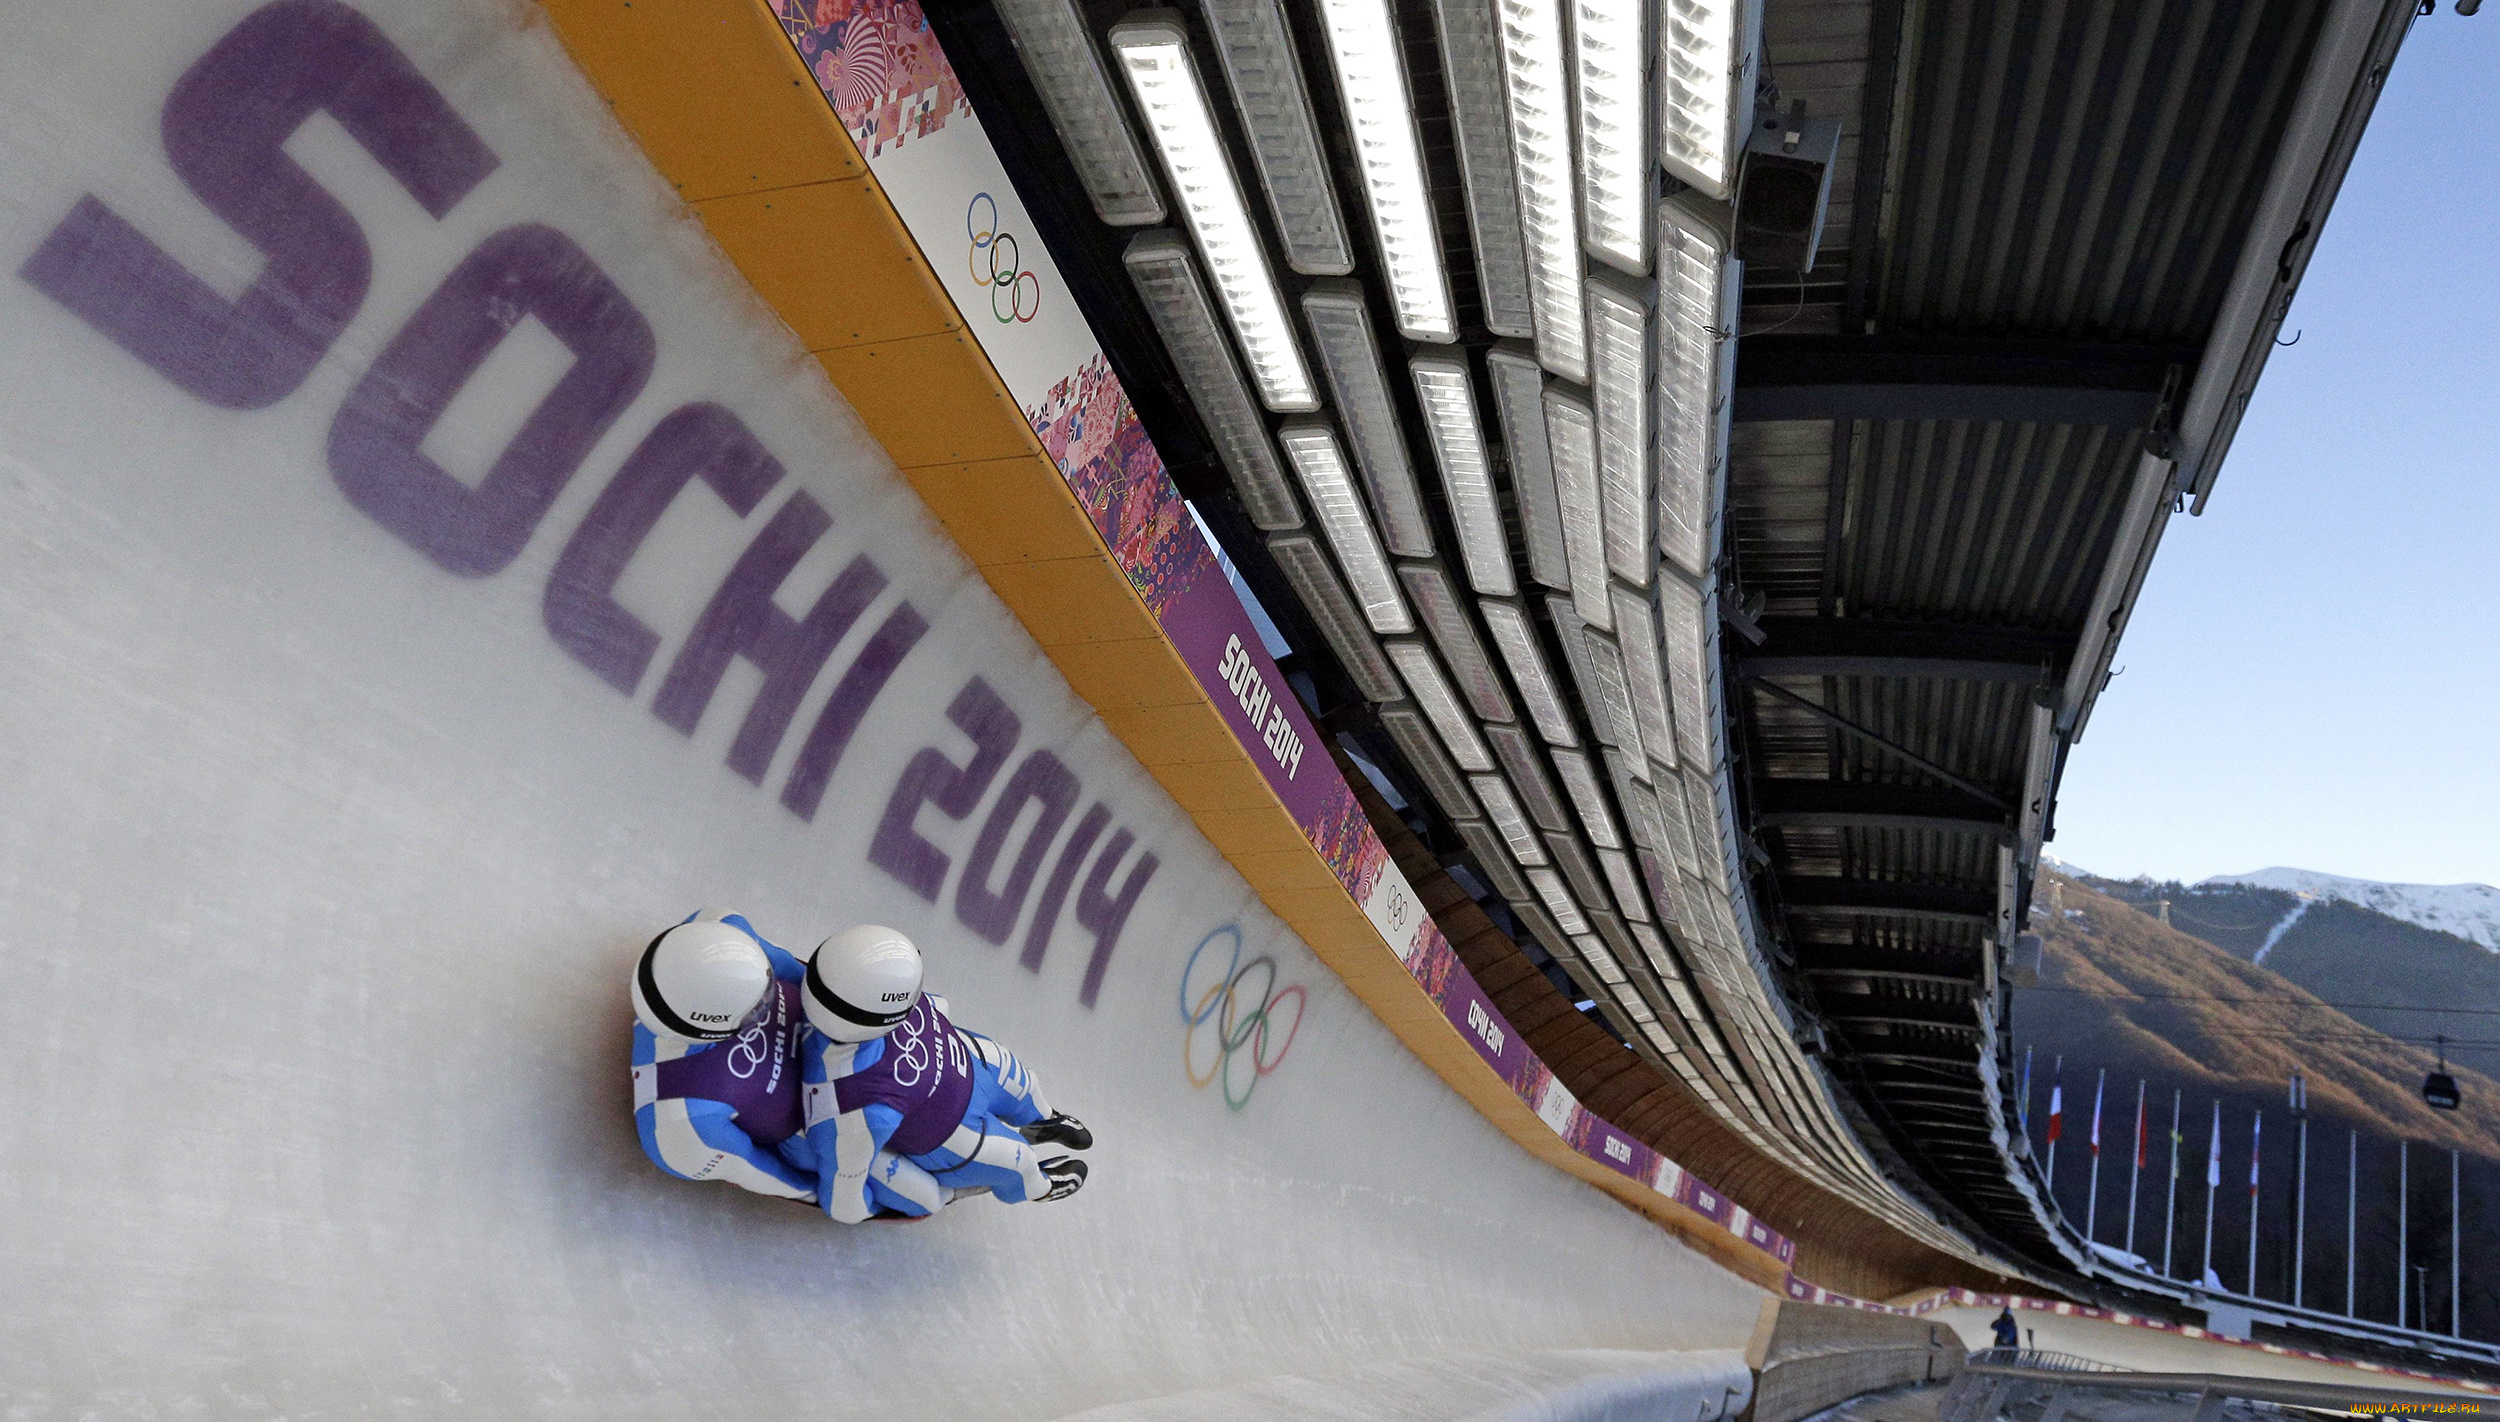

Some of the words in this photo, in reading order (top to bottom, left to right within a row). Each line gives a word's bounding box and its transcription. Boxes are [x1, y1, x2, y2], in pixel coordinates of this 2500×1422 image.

[16, 0, 929, 825] SOCHI
[867, 674, 1160, 1011] 2014
[1218, 633, 1272, 732] SOCHI
[1263, 704, 1305, 781] 2014
[690, 1011, 732, 1023] uvex
[881, 991, 911, 1002] uvex
[947, 1033, 967, 1078] 2
[1486, 1020, 1505, 1057] 2014
[766, 1031, 785, 1094] SOCHI
